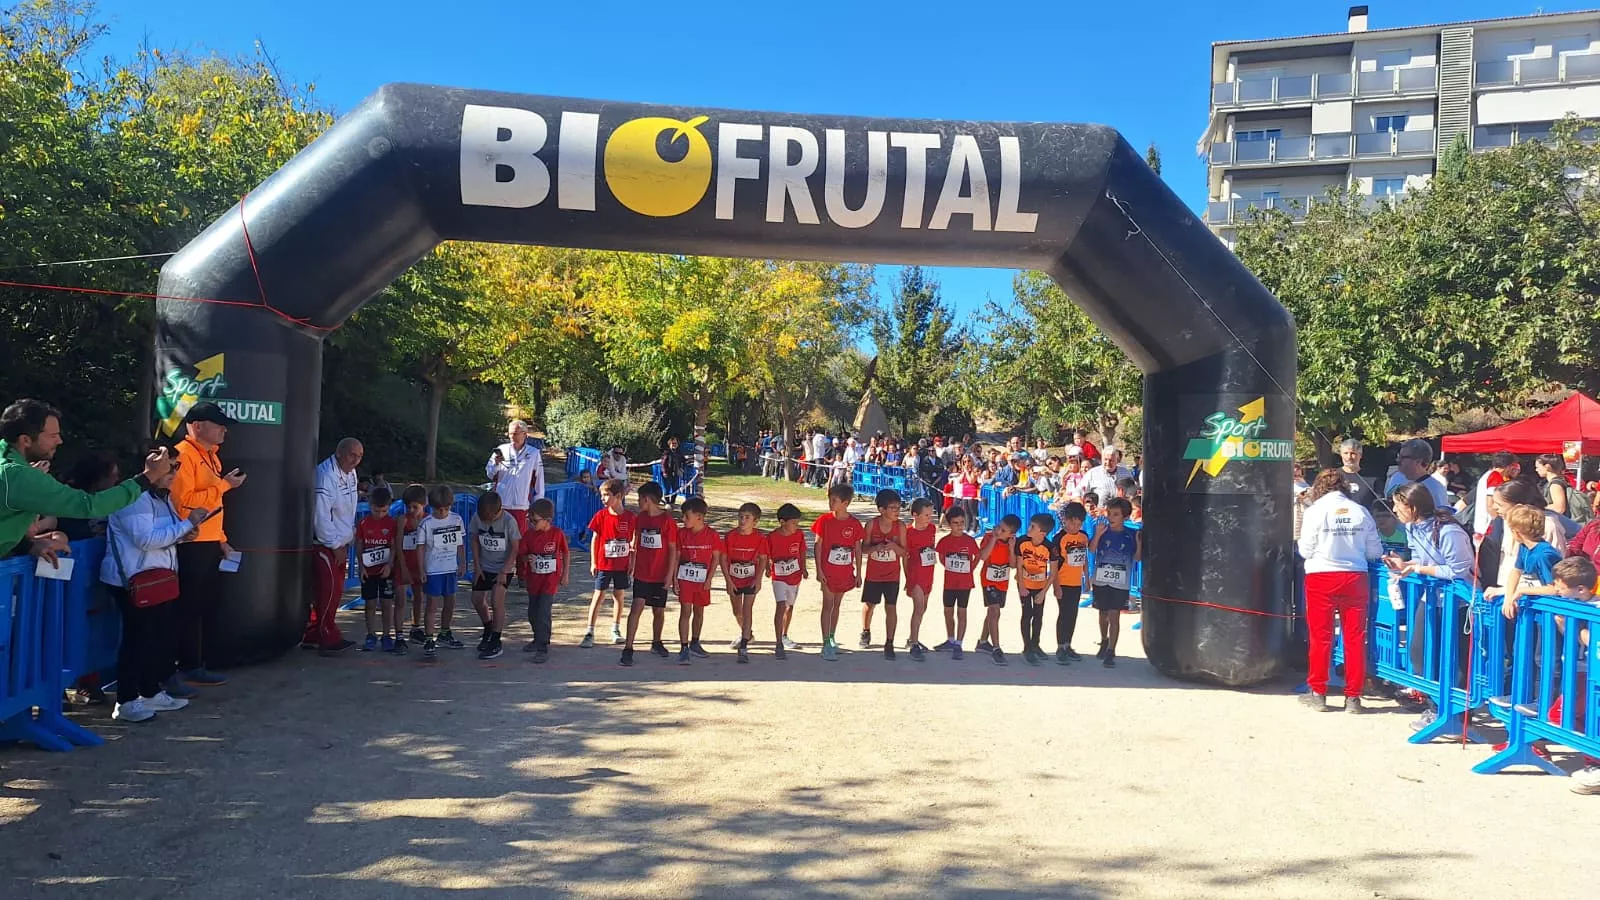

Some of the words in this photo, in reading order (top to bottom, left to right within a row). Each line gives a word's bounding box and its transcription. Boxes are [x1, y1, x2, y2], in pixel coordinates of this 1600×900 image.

[460, 103, 1038, 233] BIOFRUTAL
[163, 370, 224, 403] Sport
[1202, 413, 1265, 444] Sport
[1221, 441, 1293, 458] BIOFRUTAL
[442, 533, 457, 544] 313
[612, 545, 626, 553] 076
[370, 551, 385, 562] 337
[535, 561, 550, 569] 195
[685, 569, 699, 577] 191
[1104, 571, 1120, 579] 238
